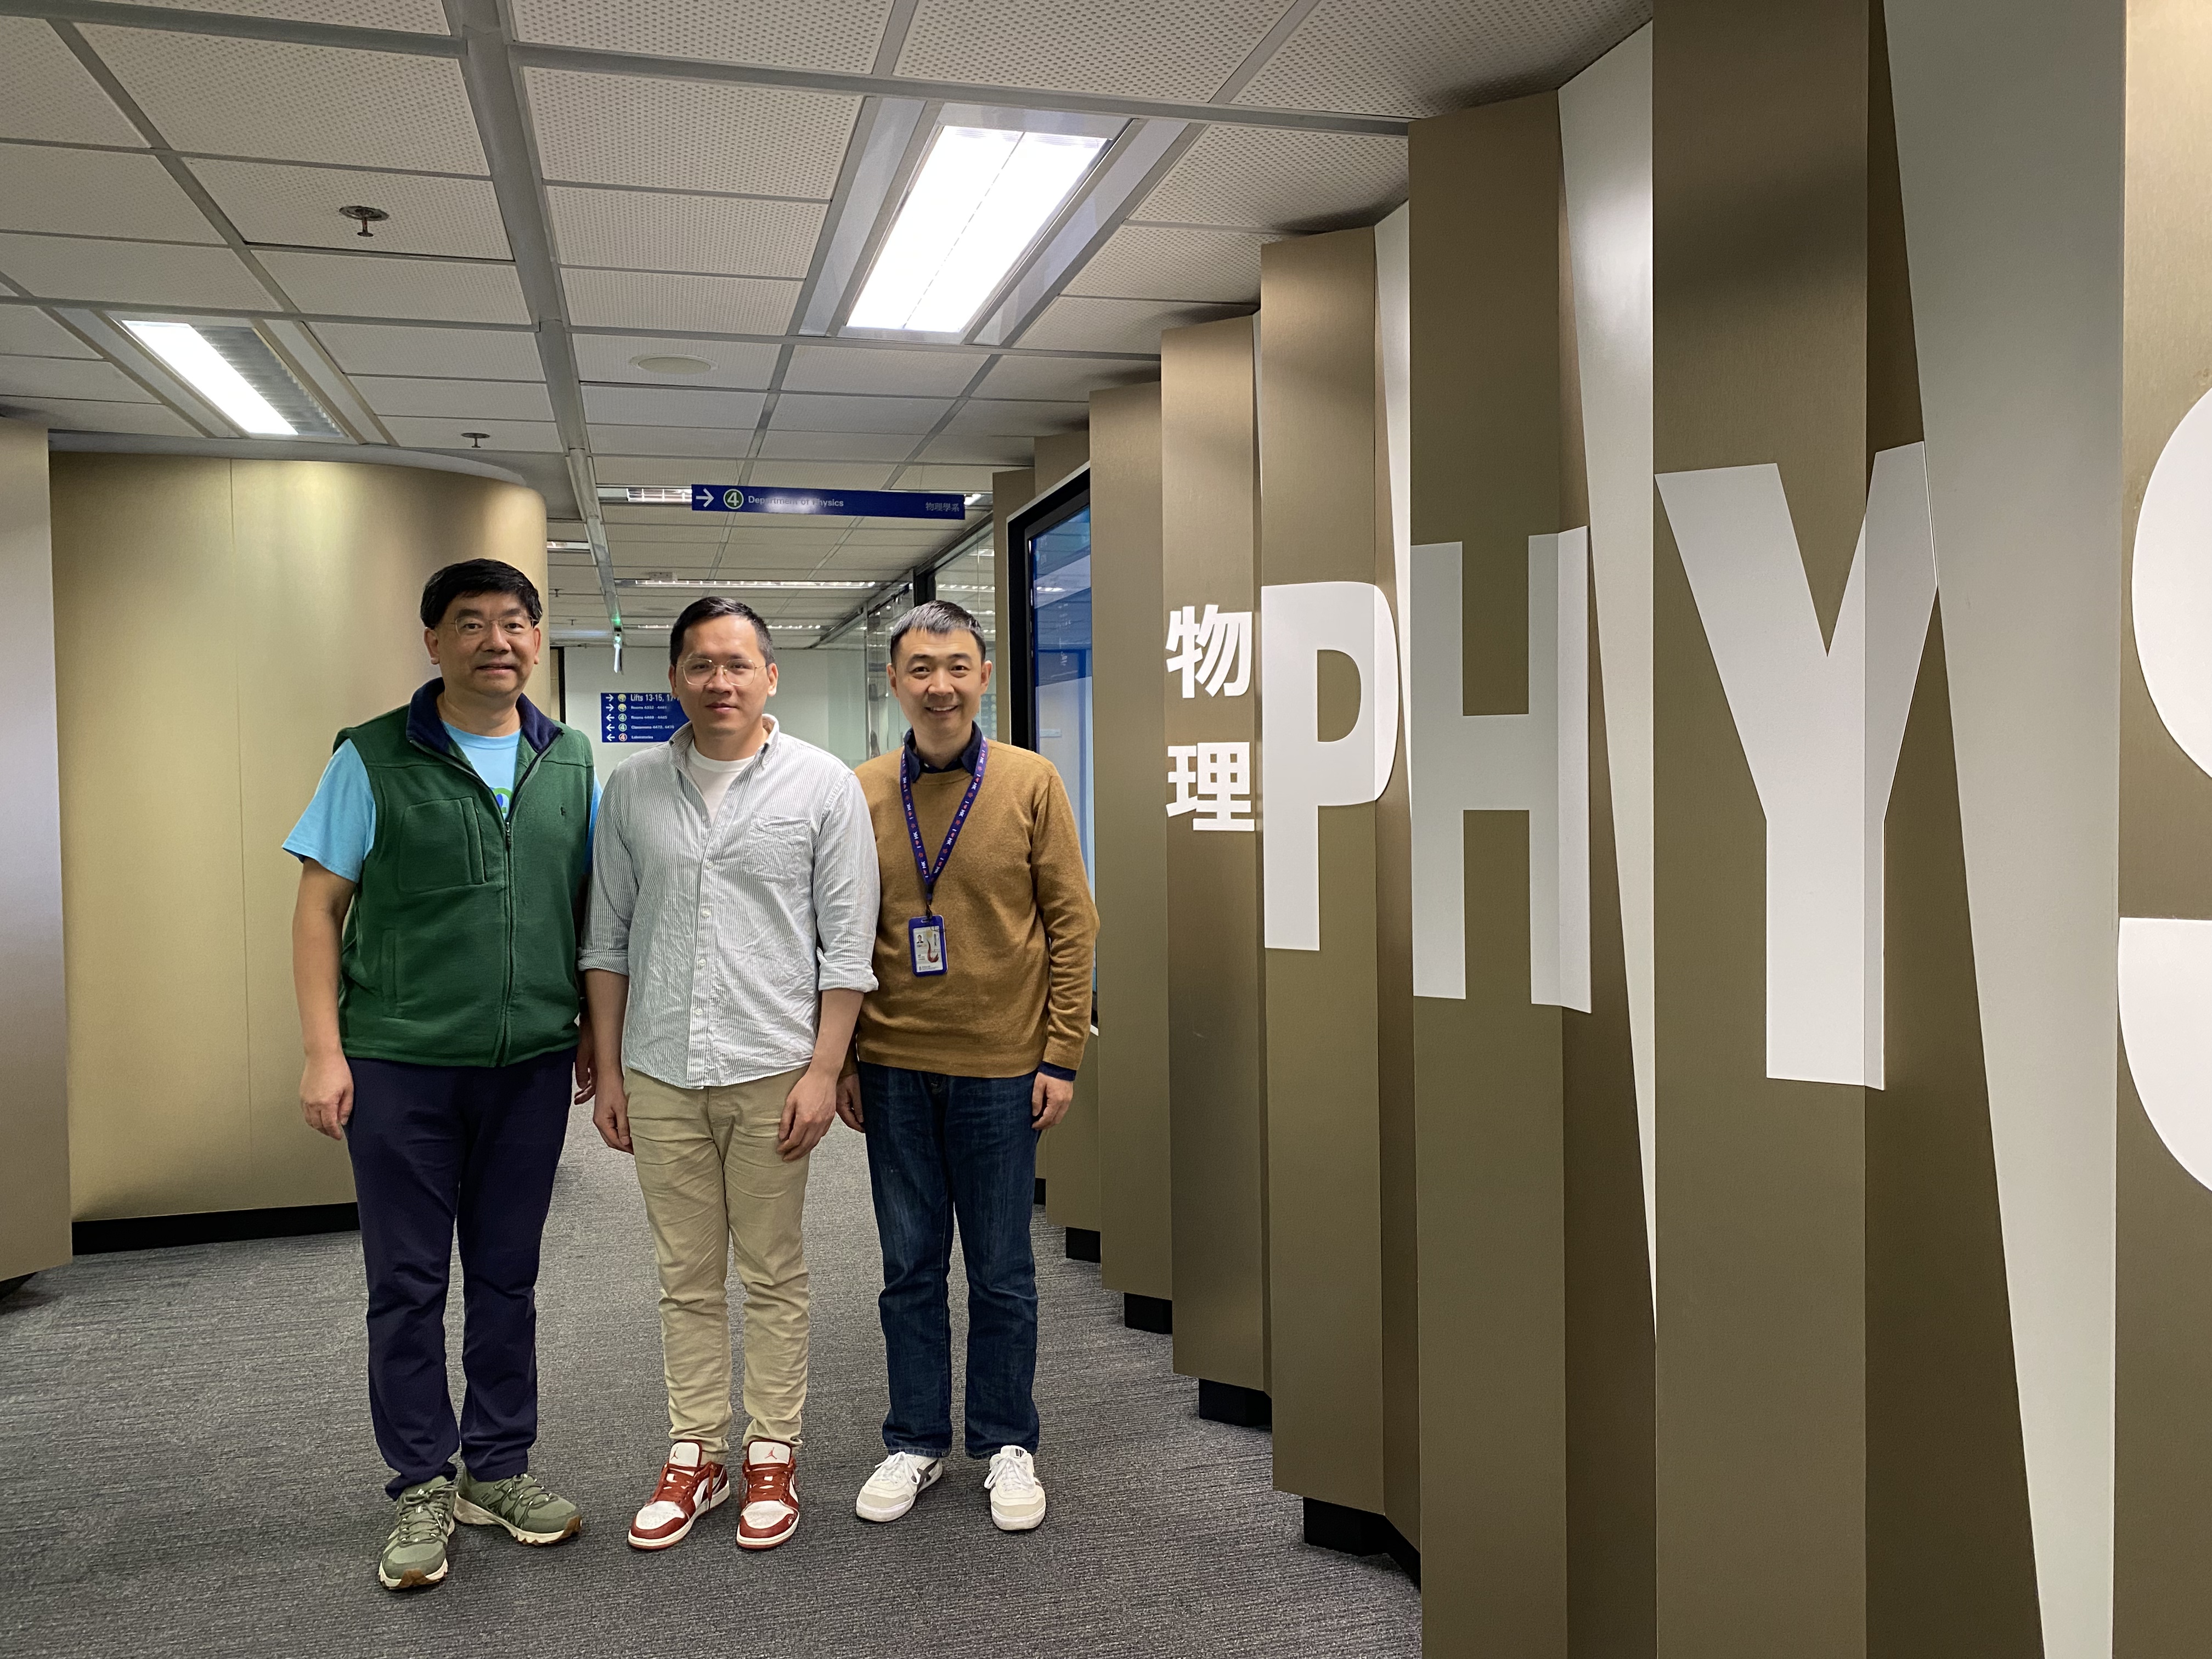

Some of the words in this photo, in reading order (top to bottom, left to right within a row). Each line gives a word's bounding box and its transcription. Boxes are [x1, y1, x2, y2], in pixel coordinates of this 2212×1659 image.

[748, 495, 797, 505] Department
[812, 498, 844, 507] Physics
[926, 502, 960, 512] 物理學系
[1165, 604, 1255, 832] 物理
